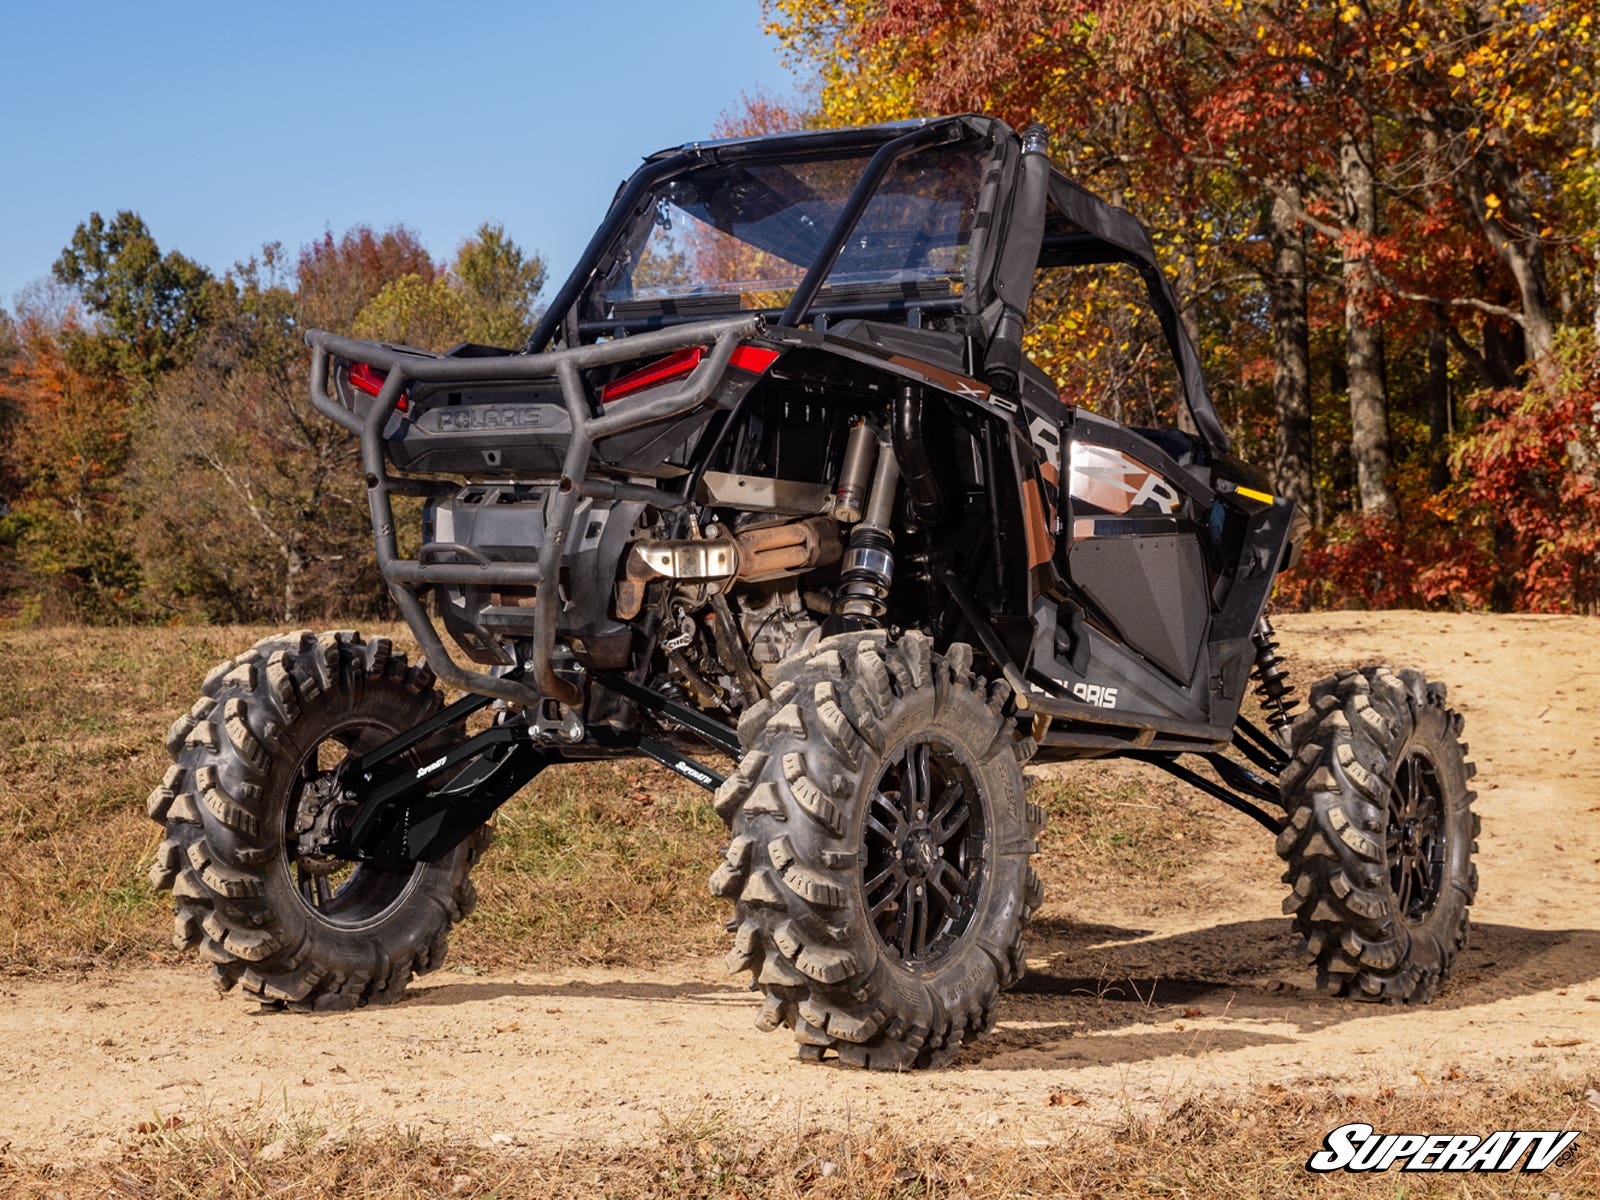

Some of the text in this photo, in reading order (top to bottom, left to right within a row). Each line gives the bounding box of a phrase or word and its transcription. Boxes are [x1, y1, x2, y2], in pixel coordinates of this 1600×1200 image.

[956, 381, 1018, 413] XP
[437, 406, 543, 431] POLARIS
[1030, 678, 1118, 709] ARIS
